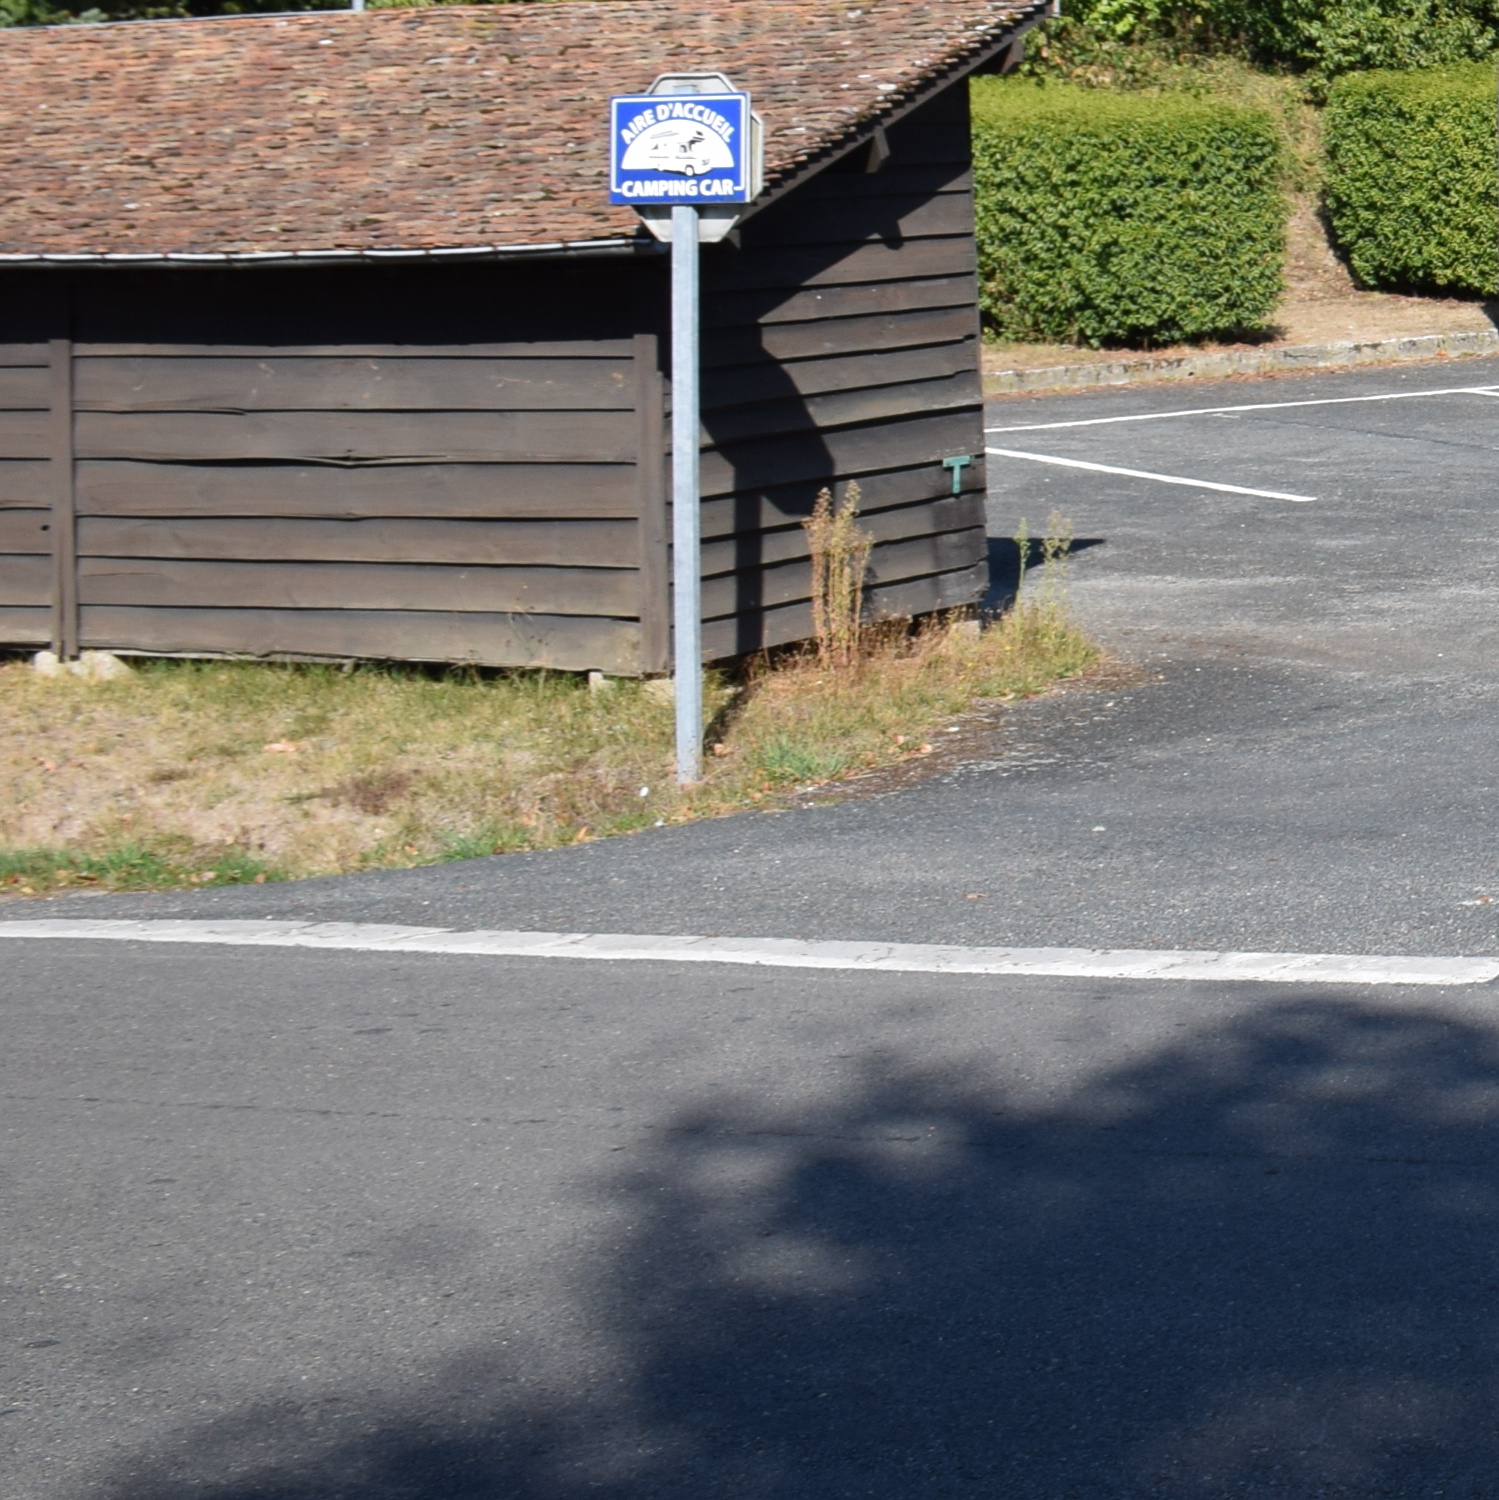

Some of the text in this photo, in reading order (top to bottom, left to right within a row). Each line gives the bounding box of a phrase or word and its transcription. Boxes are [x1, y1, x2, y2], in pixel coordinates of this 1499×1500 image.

[620, 102, 736, 145] AIRE D'ACCUEIL
[621, 179, 735, 198] CAMPING CAR
